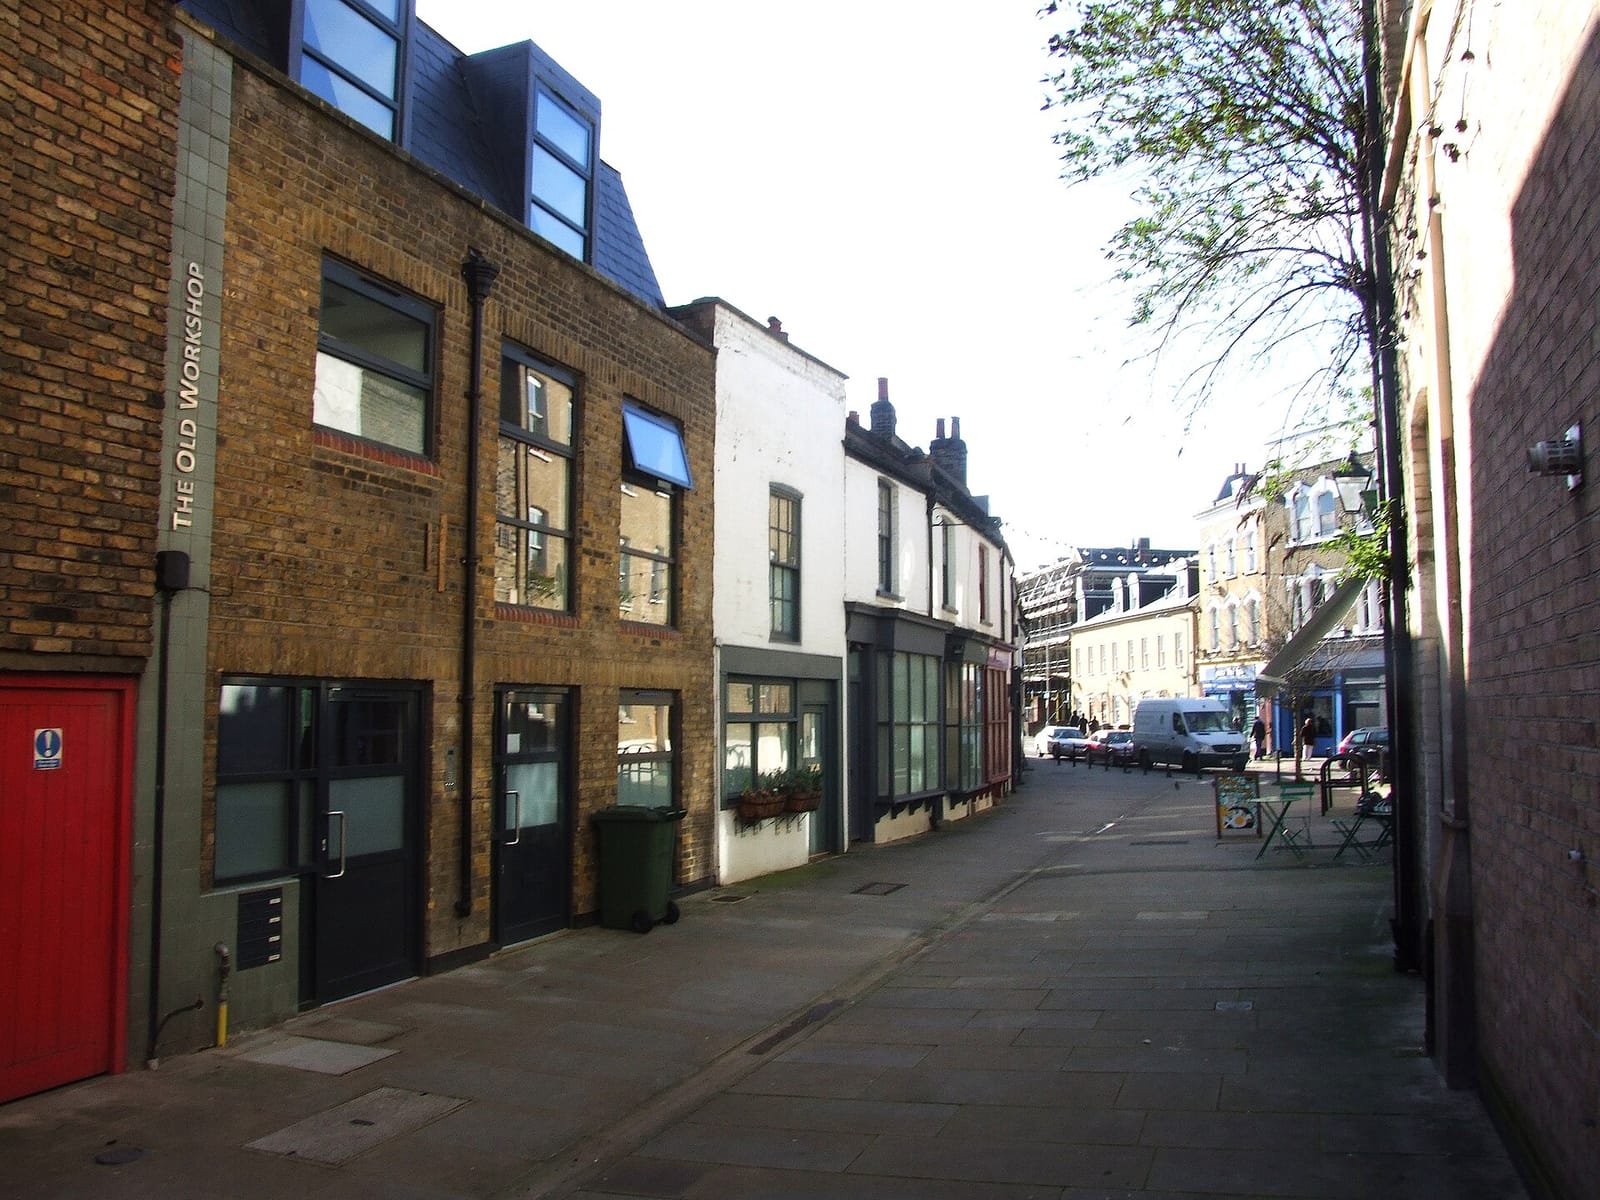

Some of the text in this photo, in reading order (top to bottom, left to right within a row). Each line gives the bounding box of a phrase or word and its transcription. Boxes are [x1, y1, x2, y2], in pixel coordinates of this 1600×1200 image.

[172, 261, 205, 531] THE OLD WORKSHOP
